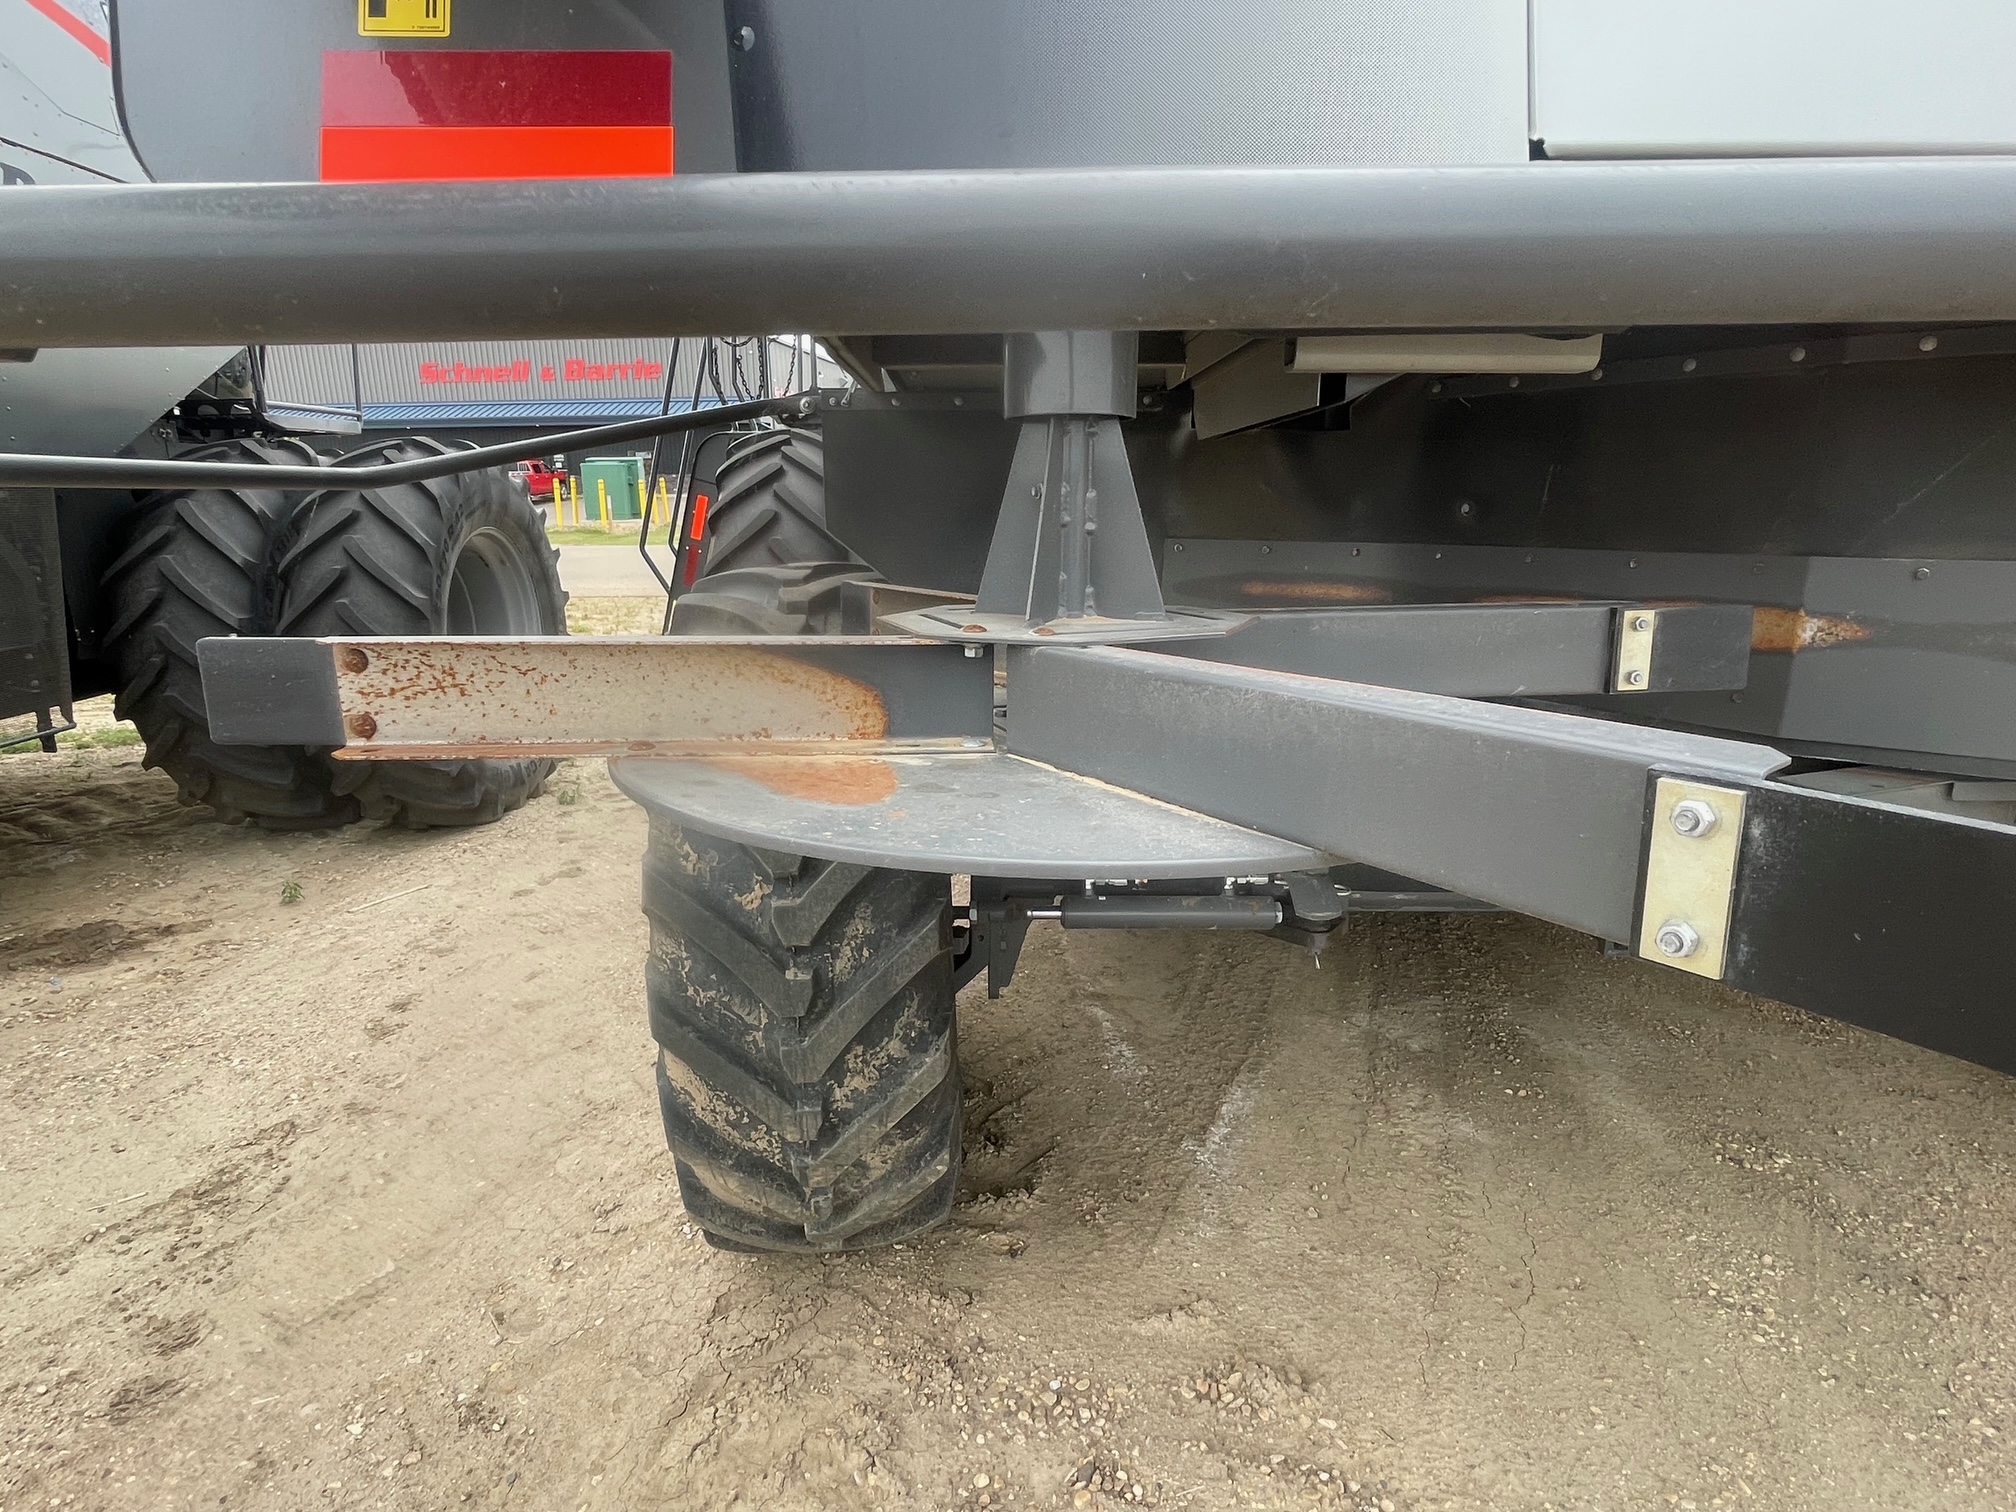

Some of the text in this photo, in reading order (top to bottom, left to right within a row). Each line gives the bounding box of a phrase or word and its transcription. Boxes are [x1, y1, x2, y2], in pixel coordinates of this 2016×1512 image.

[420, 358, 662, 384] Schnell & Barrie
